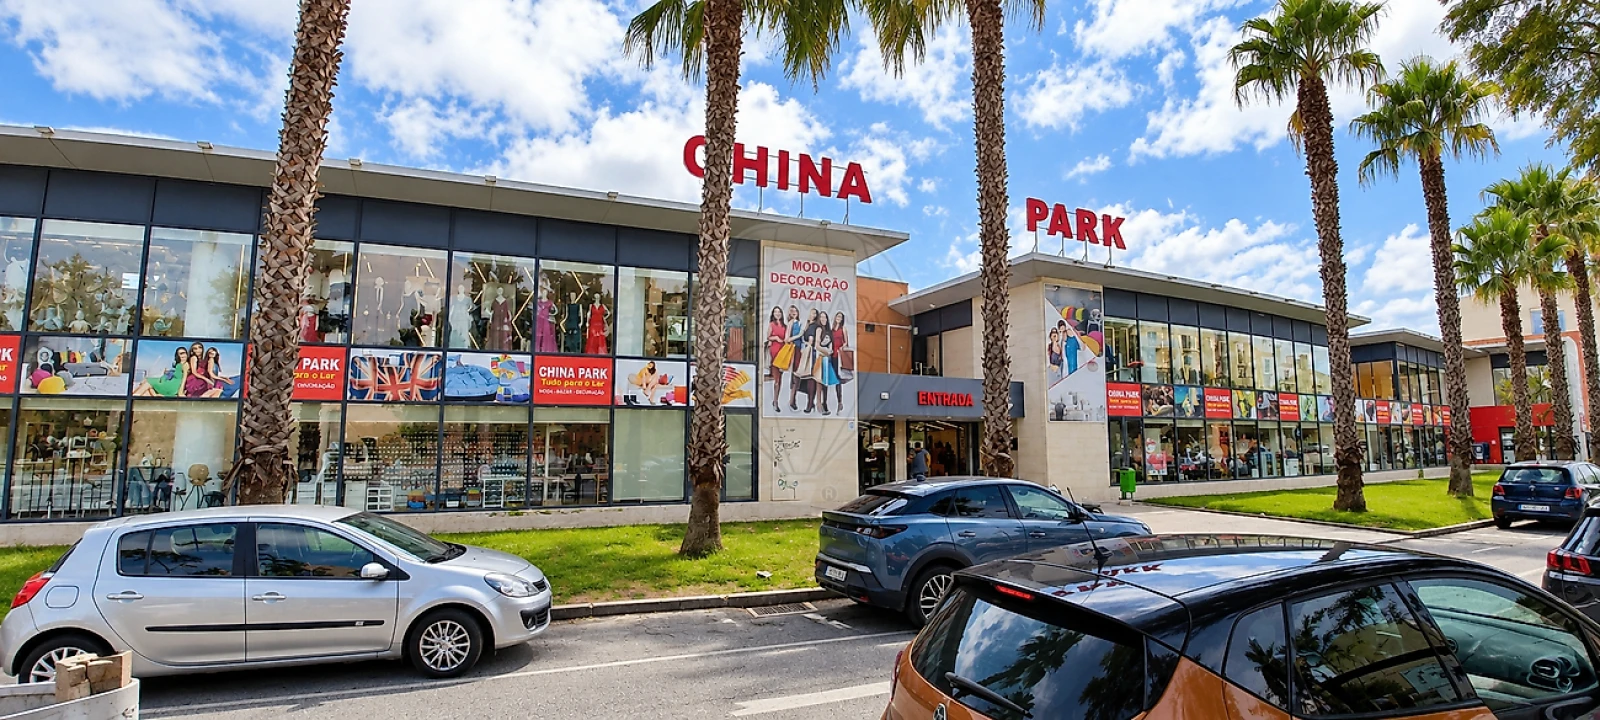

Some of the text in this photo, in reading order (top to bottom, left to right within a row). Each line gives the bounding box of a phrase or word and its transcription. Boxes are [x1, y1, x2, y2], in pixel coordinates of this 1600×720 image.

[683, 135, 872, 203] CHINA
[1026, 197, 1126, 250] PARK
[792, 260, 829, 274] MODA
[770, 272, 849, 291] DECORAÇÃO
[790, 288, 832, 302] BAZAR
[302, 357, 340, 371] PARK
[539, 366, 608, 379] CHINA PARK
[541, 378, 562, 386] Tudo
[564, 380, 583, 388] para
[917, 390, 974, 407] ENTRADA
